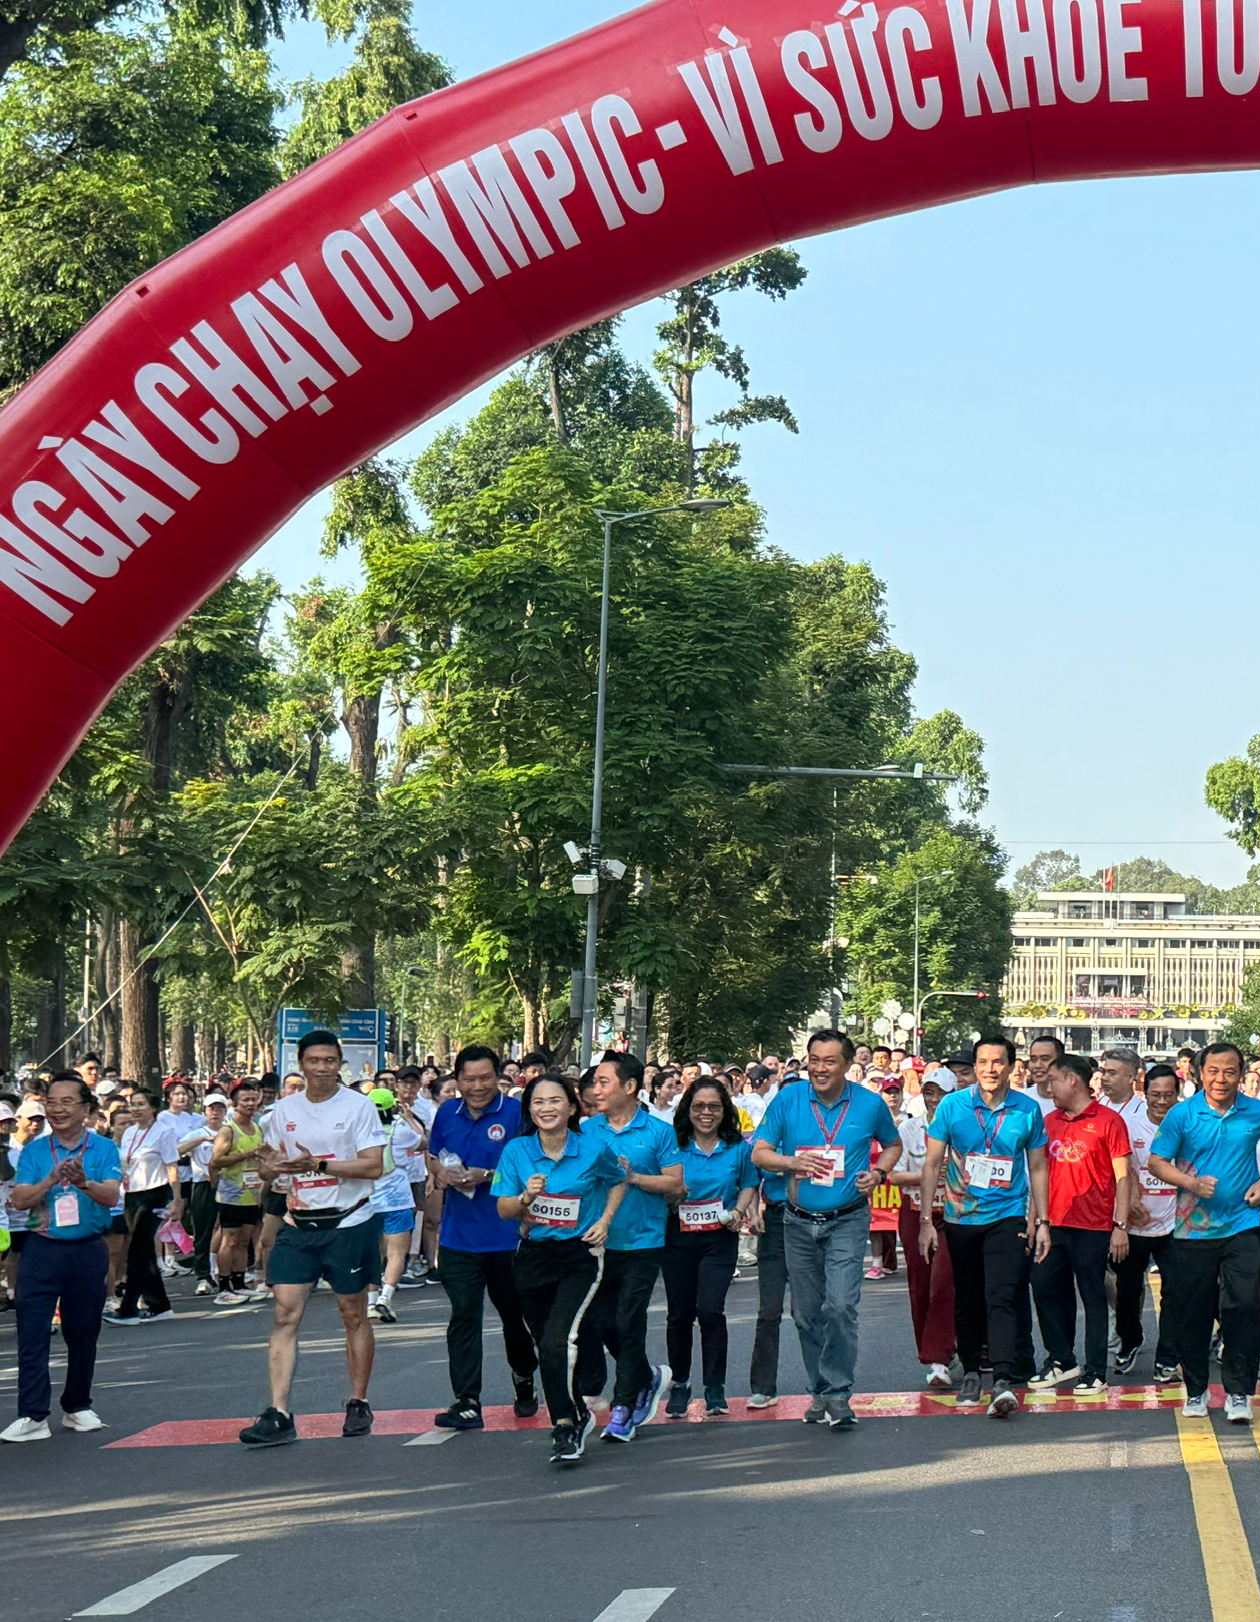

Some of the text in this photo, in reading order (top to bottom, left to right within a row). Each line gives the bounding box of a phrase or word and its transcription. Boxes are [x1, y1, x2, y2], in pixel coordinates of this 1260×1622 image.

[0, 400, 200, 627] NGÀY
[135, 261, 362, 464] CHẠY
[322, 94, 665, 342] OLYMPIC
[677, 25, 784, 176] VÌ
[781, 0, 943, 153] SỨC
[686, 1210, 717, 1222] 50137
